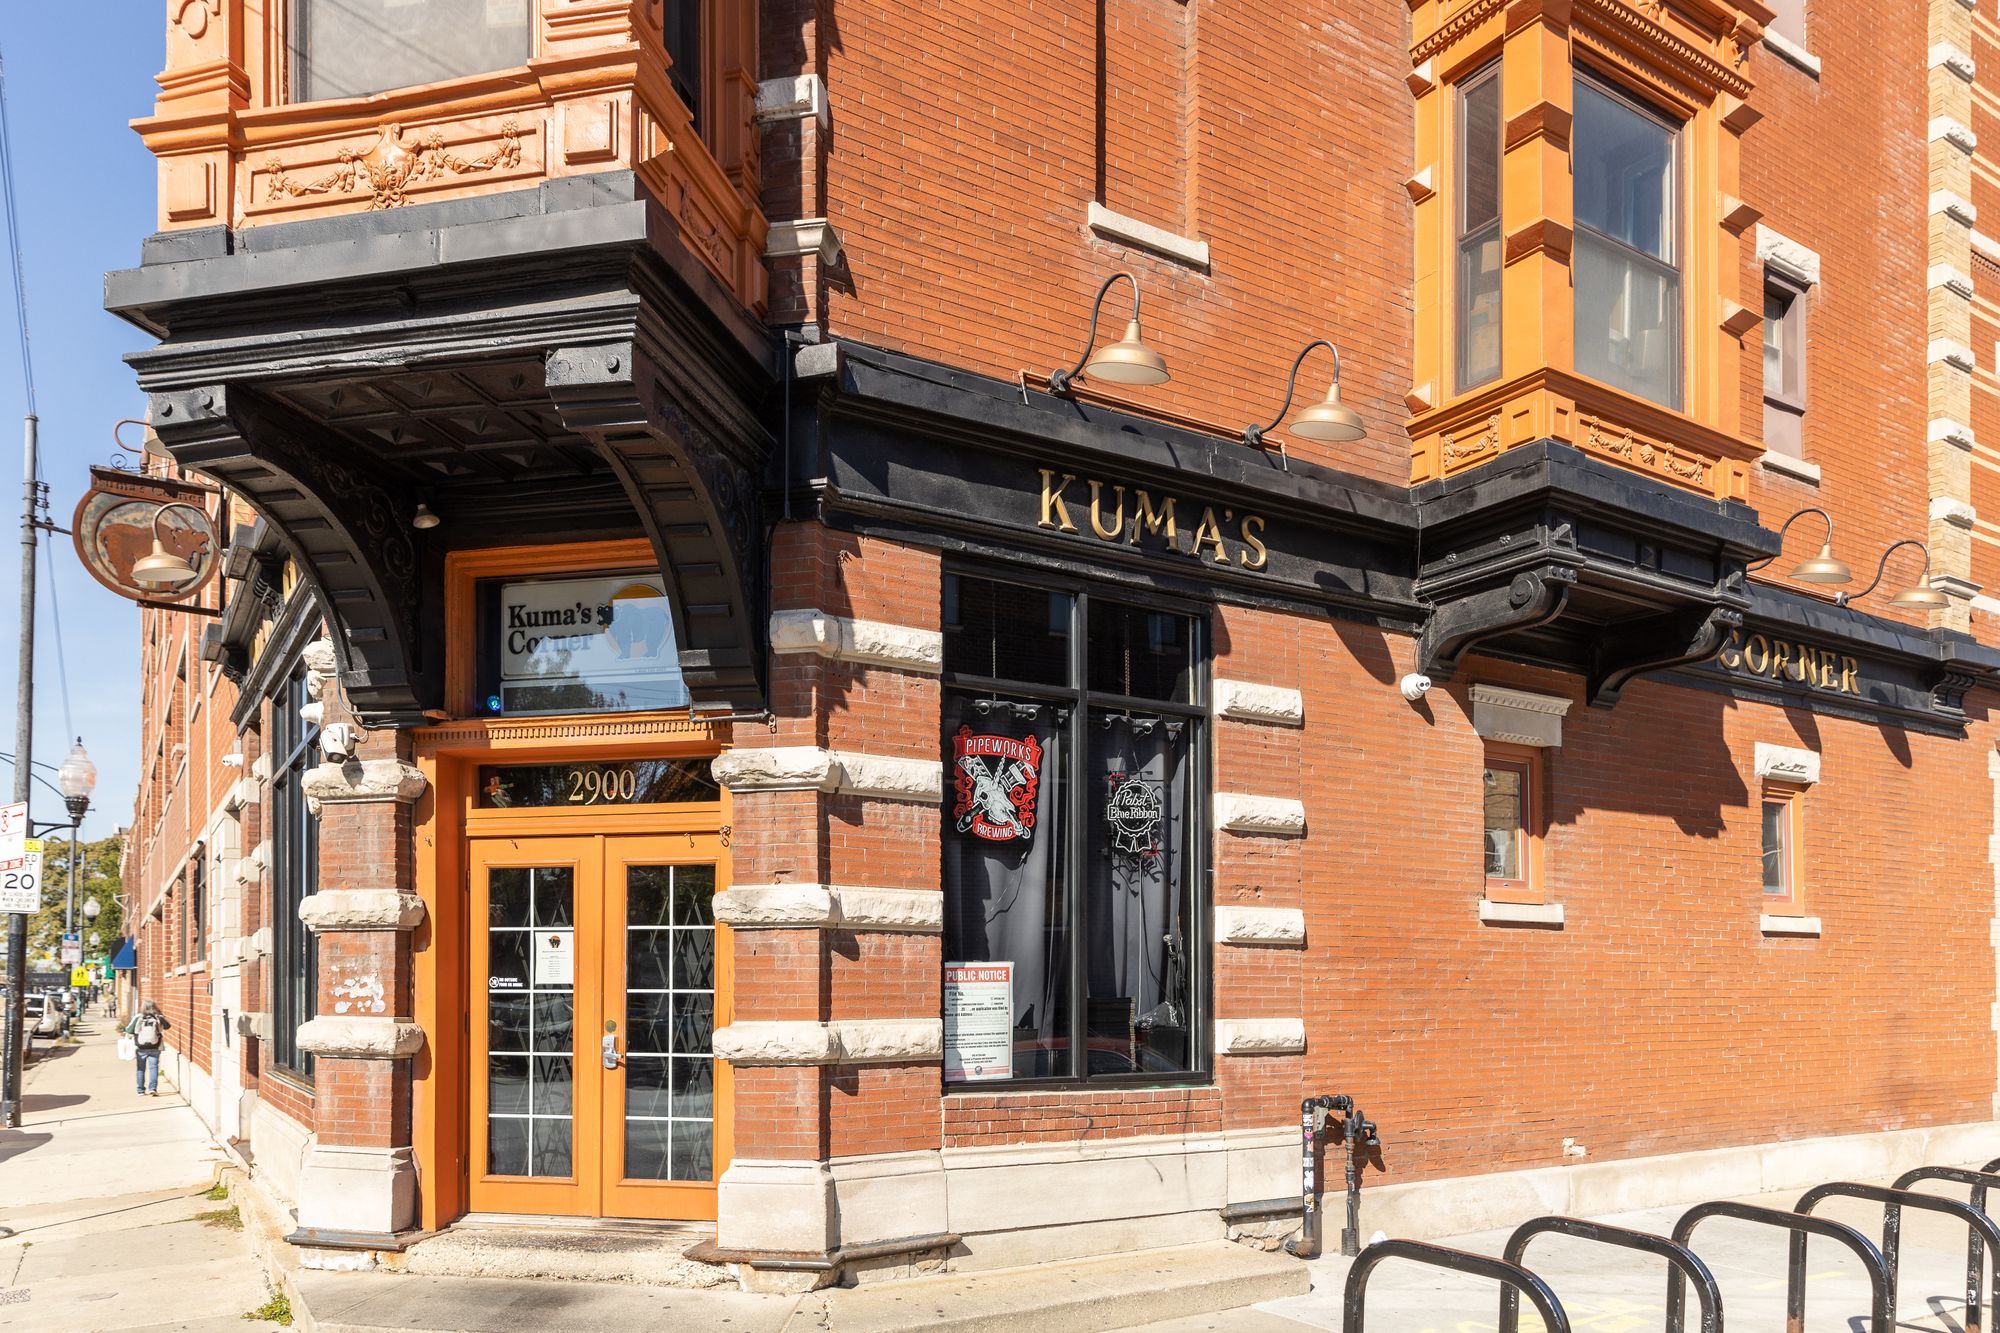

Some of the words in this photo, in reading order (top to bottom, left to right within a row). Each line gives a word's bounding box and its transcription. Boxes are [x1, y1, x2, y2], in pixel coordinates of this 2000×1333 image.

[151, 487, 204, 503] Coner
[1037, 468, 1268, 570] KUMA'S
[508, 602, 592, 628] Kuma's
[508, 630, 594, 655] Corner
[1719, 630, 1861, 696] CORNER
[966, 738, 1032, 761] PIPEWORKS
[568, 769, 636, 805] 2900
[1120, 789, 1150, 806] Pabst
[1110, 806, 1130, 819] Blue
[1130, 806, 1158, 819] Ribbon
[977, 823, 1013, 838] BREWING
[5, 873, 35, 890] 20
[946, 970, 976, 981] PUBLIC
[978, 970, 1007, 981] NOTICE
